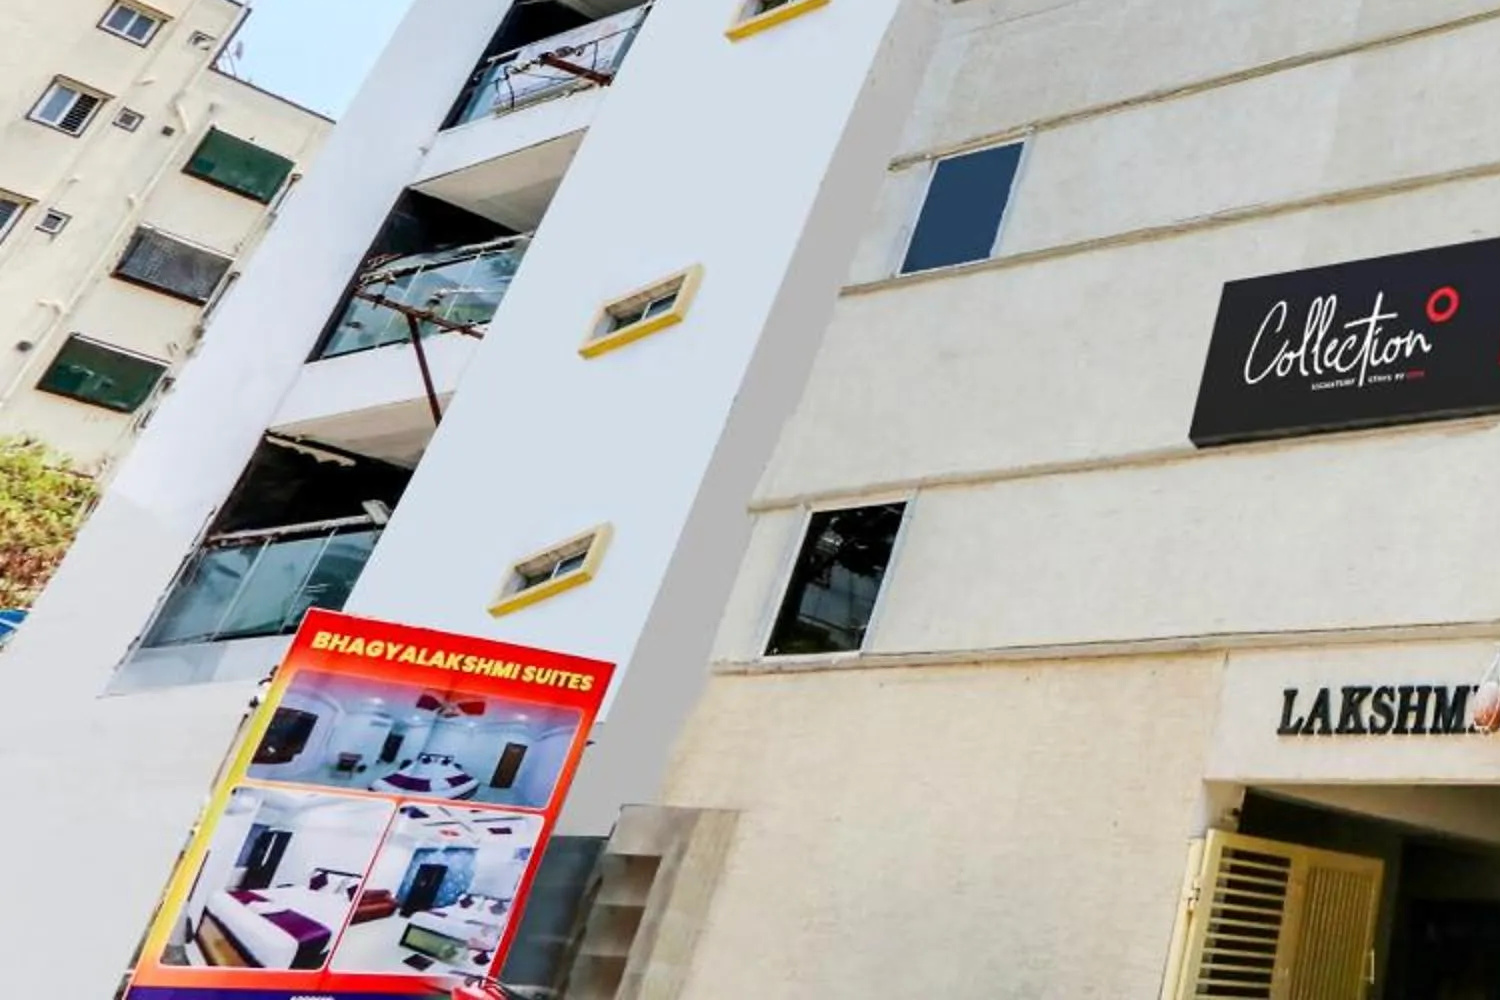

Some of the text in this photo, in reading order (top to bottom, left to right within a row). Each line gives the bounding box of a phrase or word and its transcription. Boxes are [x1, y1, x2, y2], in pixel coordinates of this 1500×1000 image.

[1243, 292, 1432, 386] Collection
[311, 631, 596, 692] BHAGYALAKSHMI SUITES
[1276, 685, 1494, 735] LAKSHM
